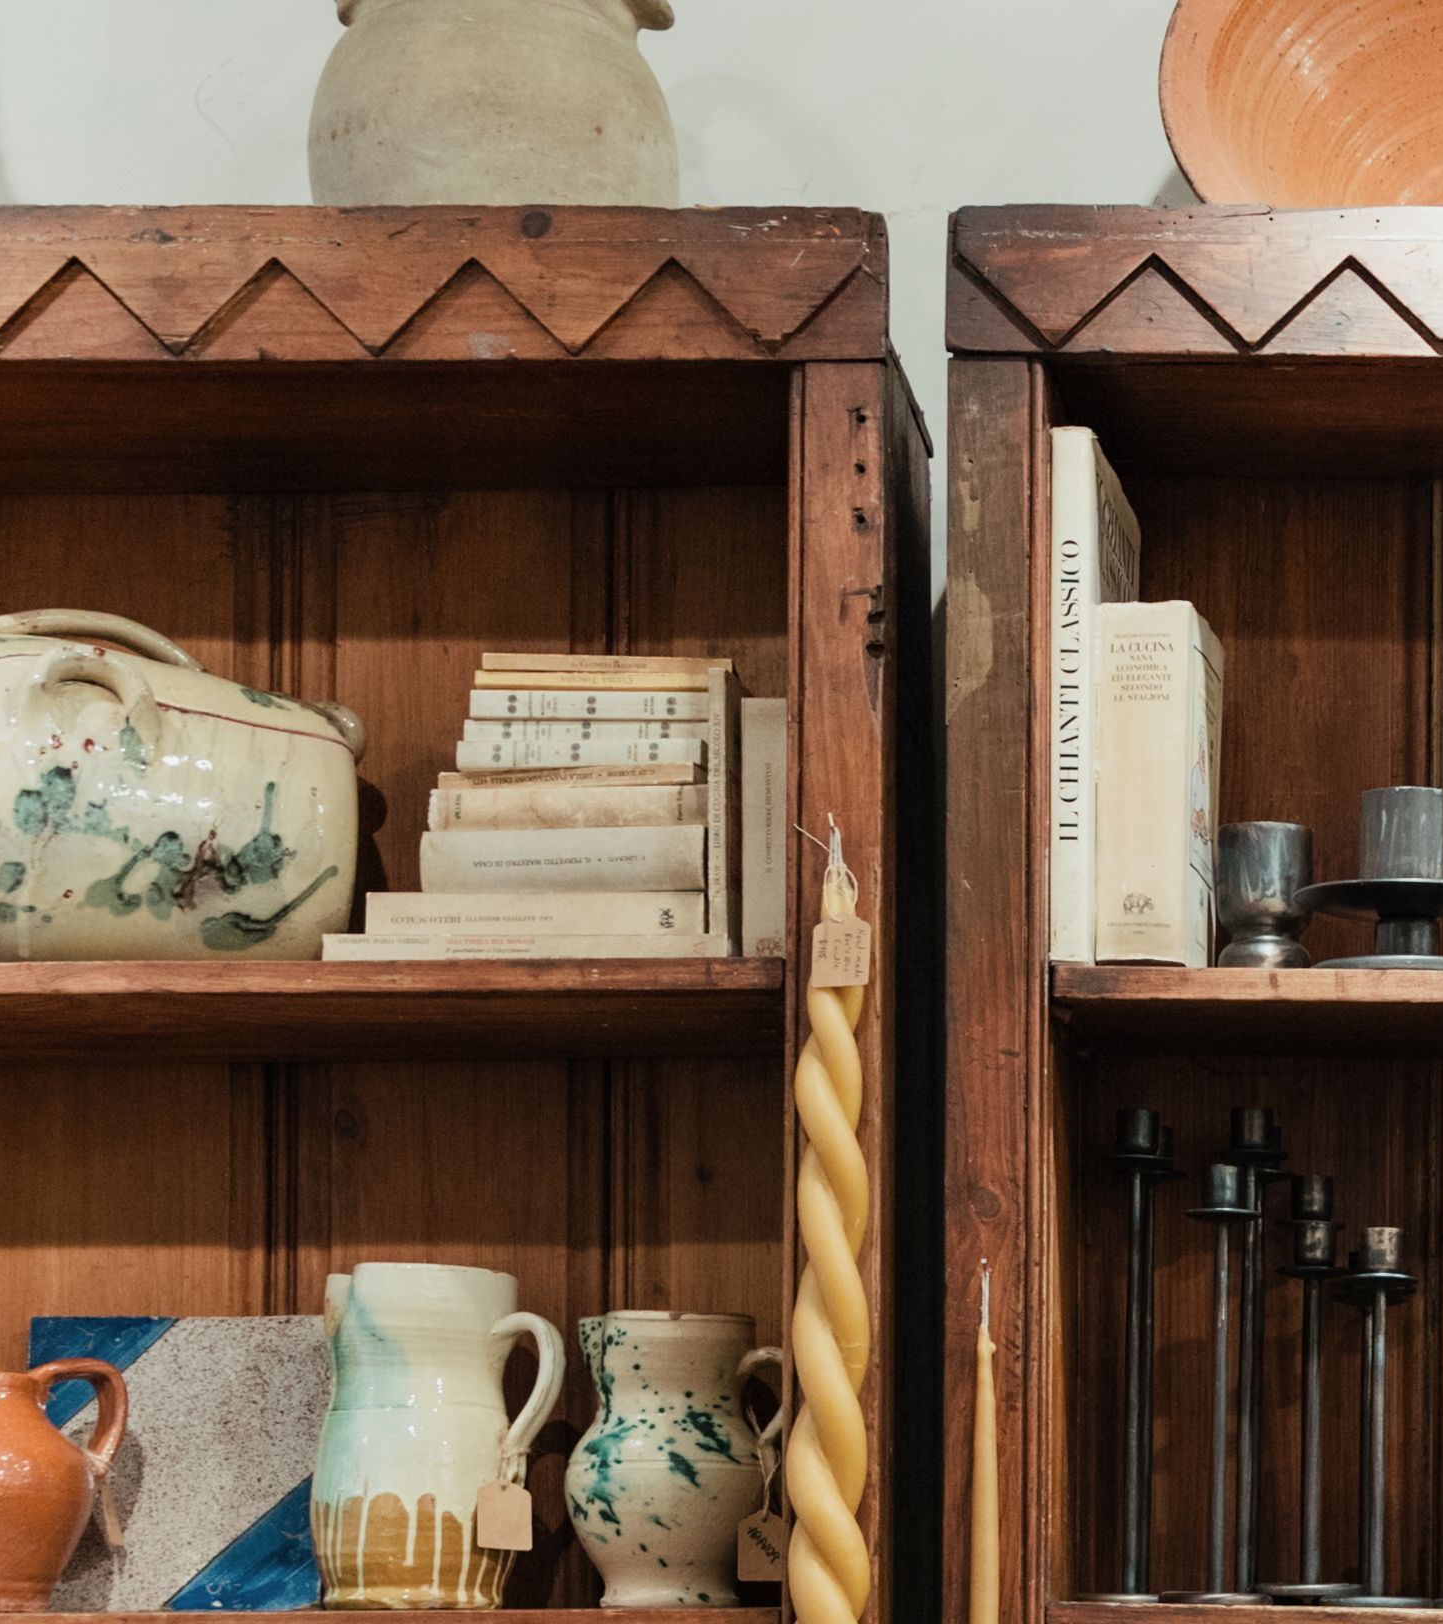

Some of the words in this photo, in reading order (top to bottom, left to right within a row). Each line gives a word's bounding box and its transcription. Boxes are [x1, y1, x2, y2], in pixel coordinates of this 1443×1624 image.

[1060, 539, 1080, 675] CLASSICO
[1110, 643, 1125, 653] LA
[1128, 641, 1174, 652] CUCINA
[1116, 664, 1168, 672] ECONOMICA
[1111, 674, 1124, 682] ED
[1126, 673, 1171, 681] ELEGANTE
[1114, 694, 1123, 702] LE
[1059, 676, 1079, 804] CHIANTI
[1059, 809, 1079, 842] IL
